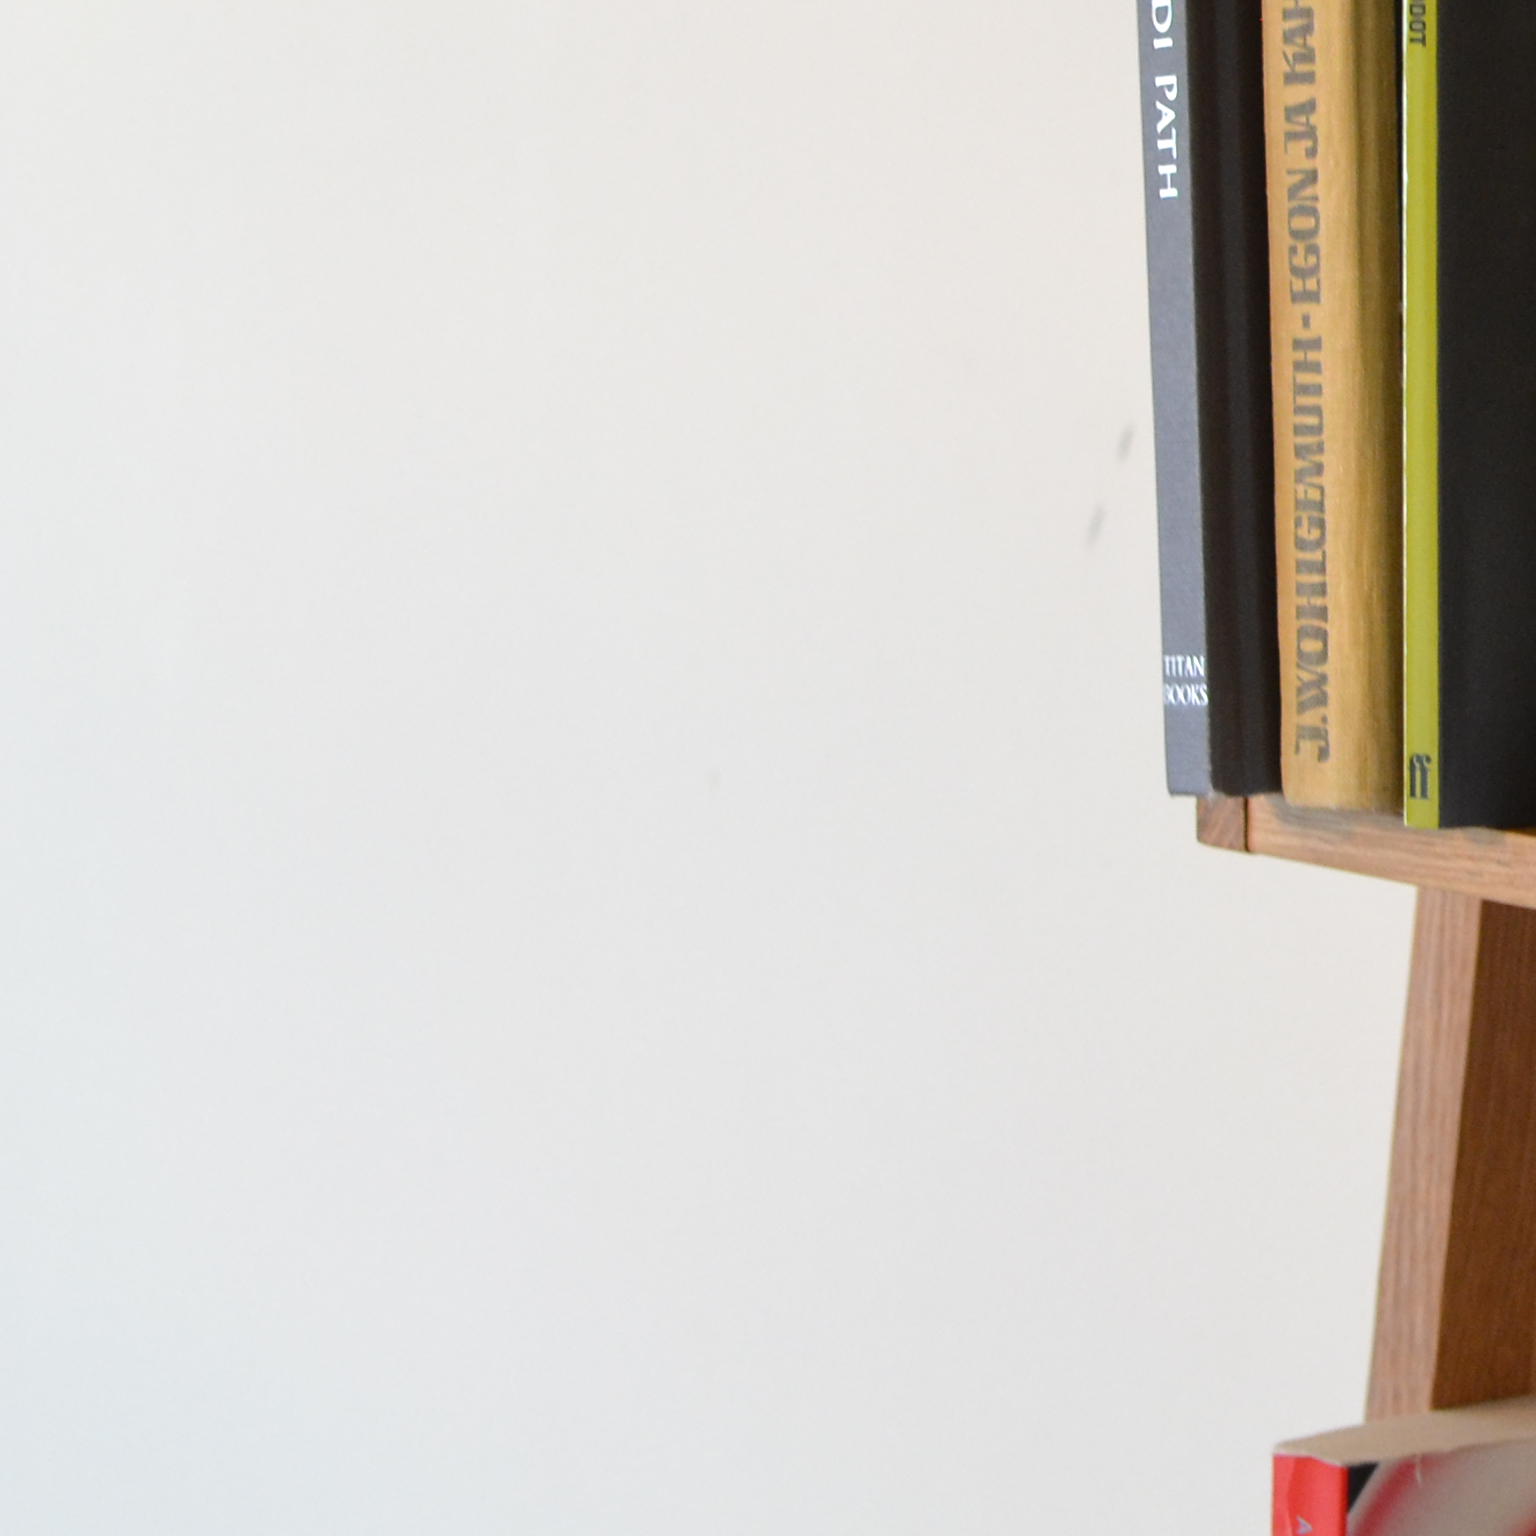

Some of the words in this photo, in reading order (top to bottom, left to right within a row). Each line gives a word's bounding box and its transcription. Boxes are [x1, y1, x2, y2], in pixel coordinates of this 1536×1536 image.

[1154, 74, 1179, 200] PATH
[1284, 96, 1320, 160] JA
[1286, 167, 1322, 305] EGON
[1163, 654, 1206, 677] TITAN
[1164, 683, 1209, 706] BOOKS
